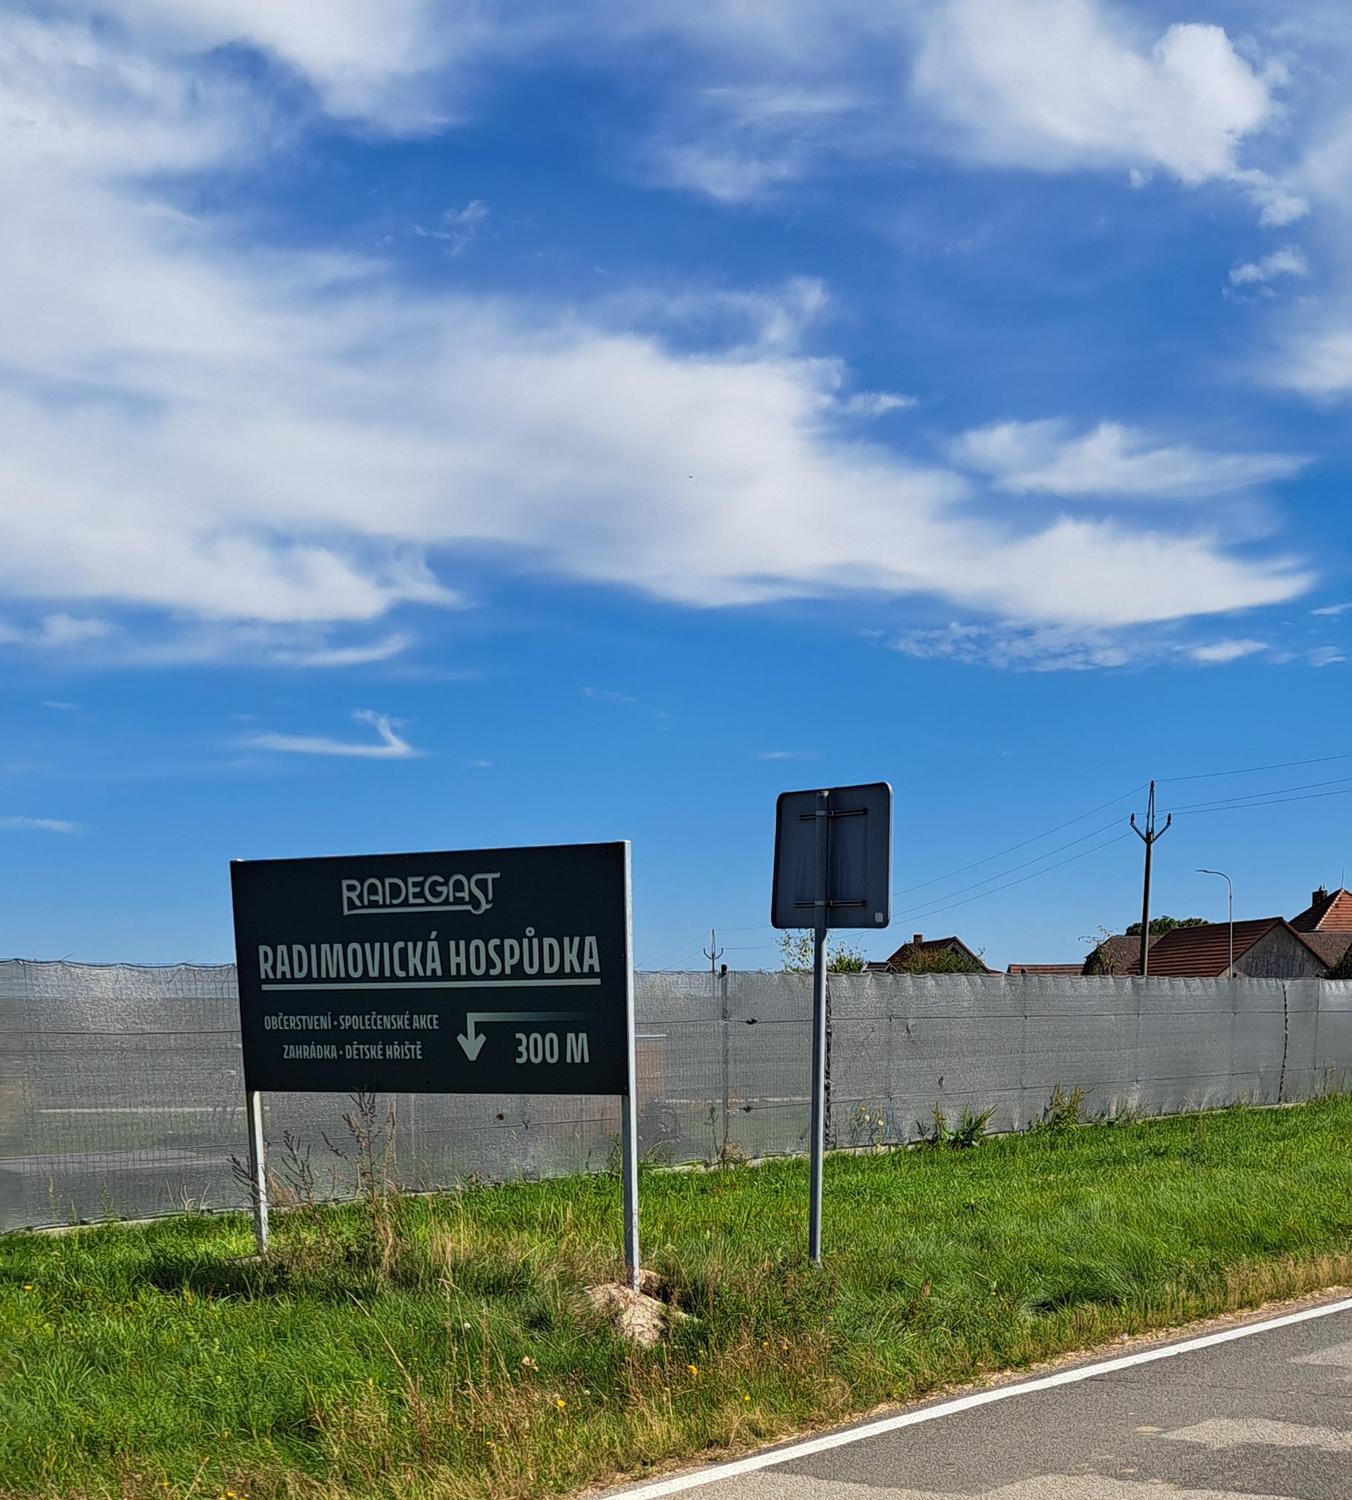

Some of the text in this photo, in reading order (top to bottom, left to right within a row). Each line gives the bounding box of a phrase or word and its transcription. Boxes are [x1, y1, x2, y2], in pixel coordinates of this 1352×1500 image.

[342, 872, 500, 915] RADEGAST
[259, 927, 600, 978] RADIMOVICKÁ HOSPŮDKA
[265, 1011, 439, 1029] OBČERSTVENÍ SPOLEČENSKÉ AKCE
[284, 1041, 422, 1059] ZAHRÁDKA DĚTSKÉ HŘIŠTĚ
[516, 1033, 589, 1063] 300 M
